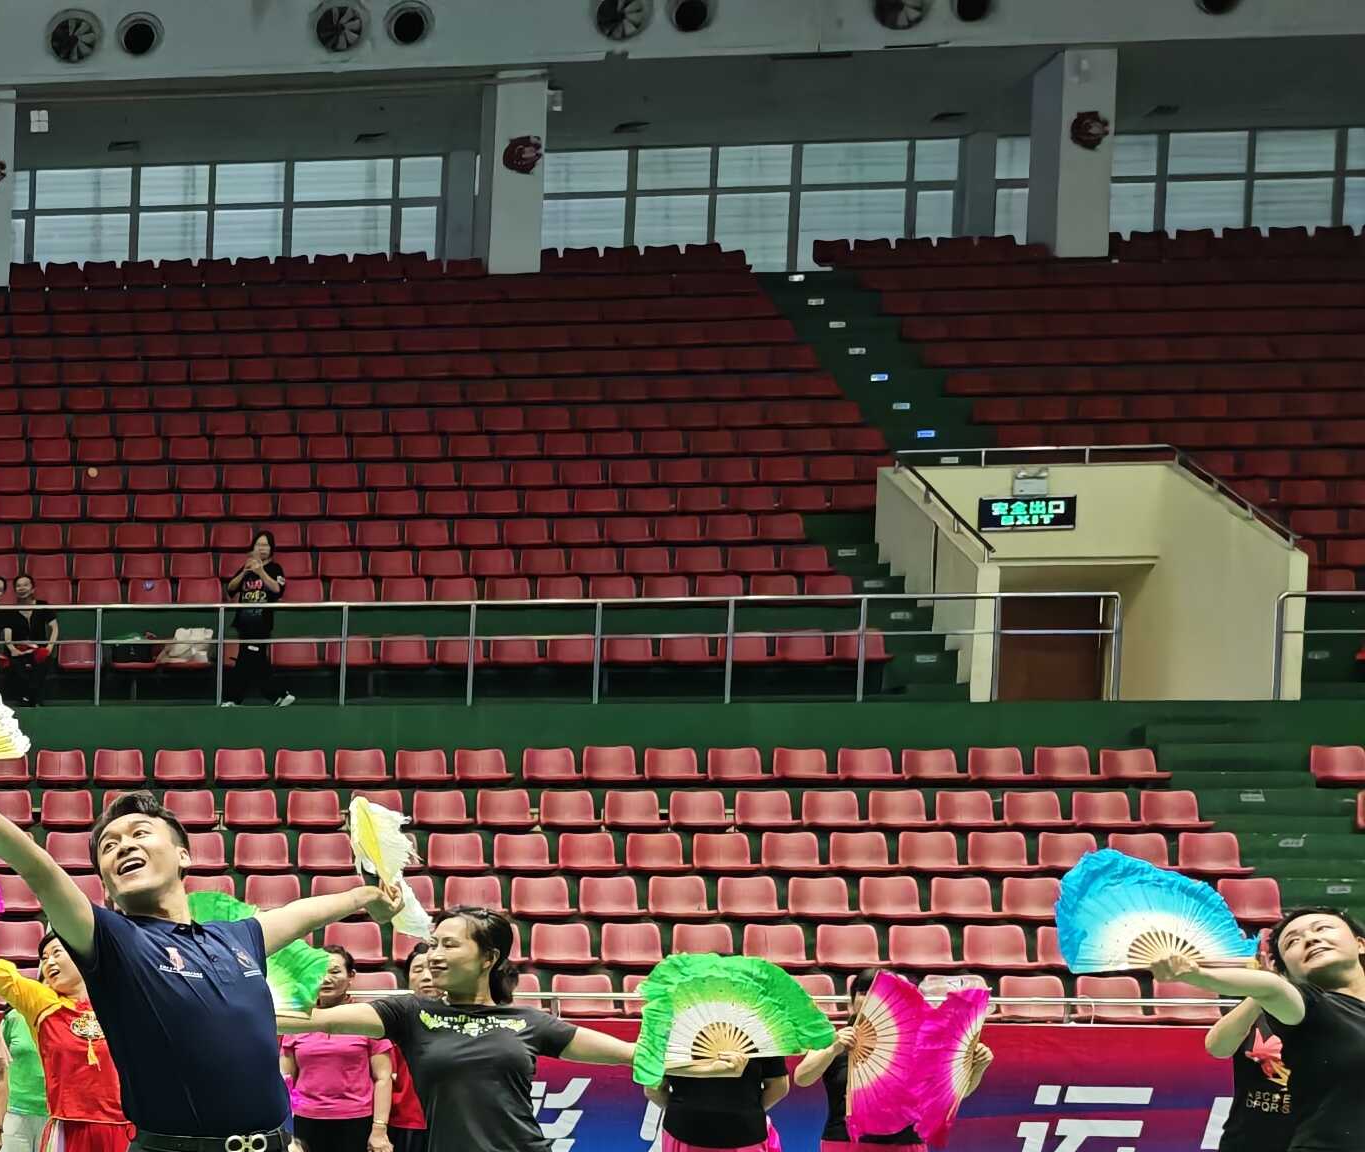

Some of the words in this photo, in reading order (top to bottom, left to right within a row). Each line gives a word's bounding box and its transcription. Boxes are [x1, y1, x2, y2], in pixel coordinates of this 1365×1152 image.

[991, 500, 1065, 515] 安全出口
[1000, 514, 1054, 526] EXIT
